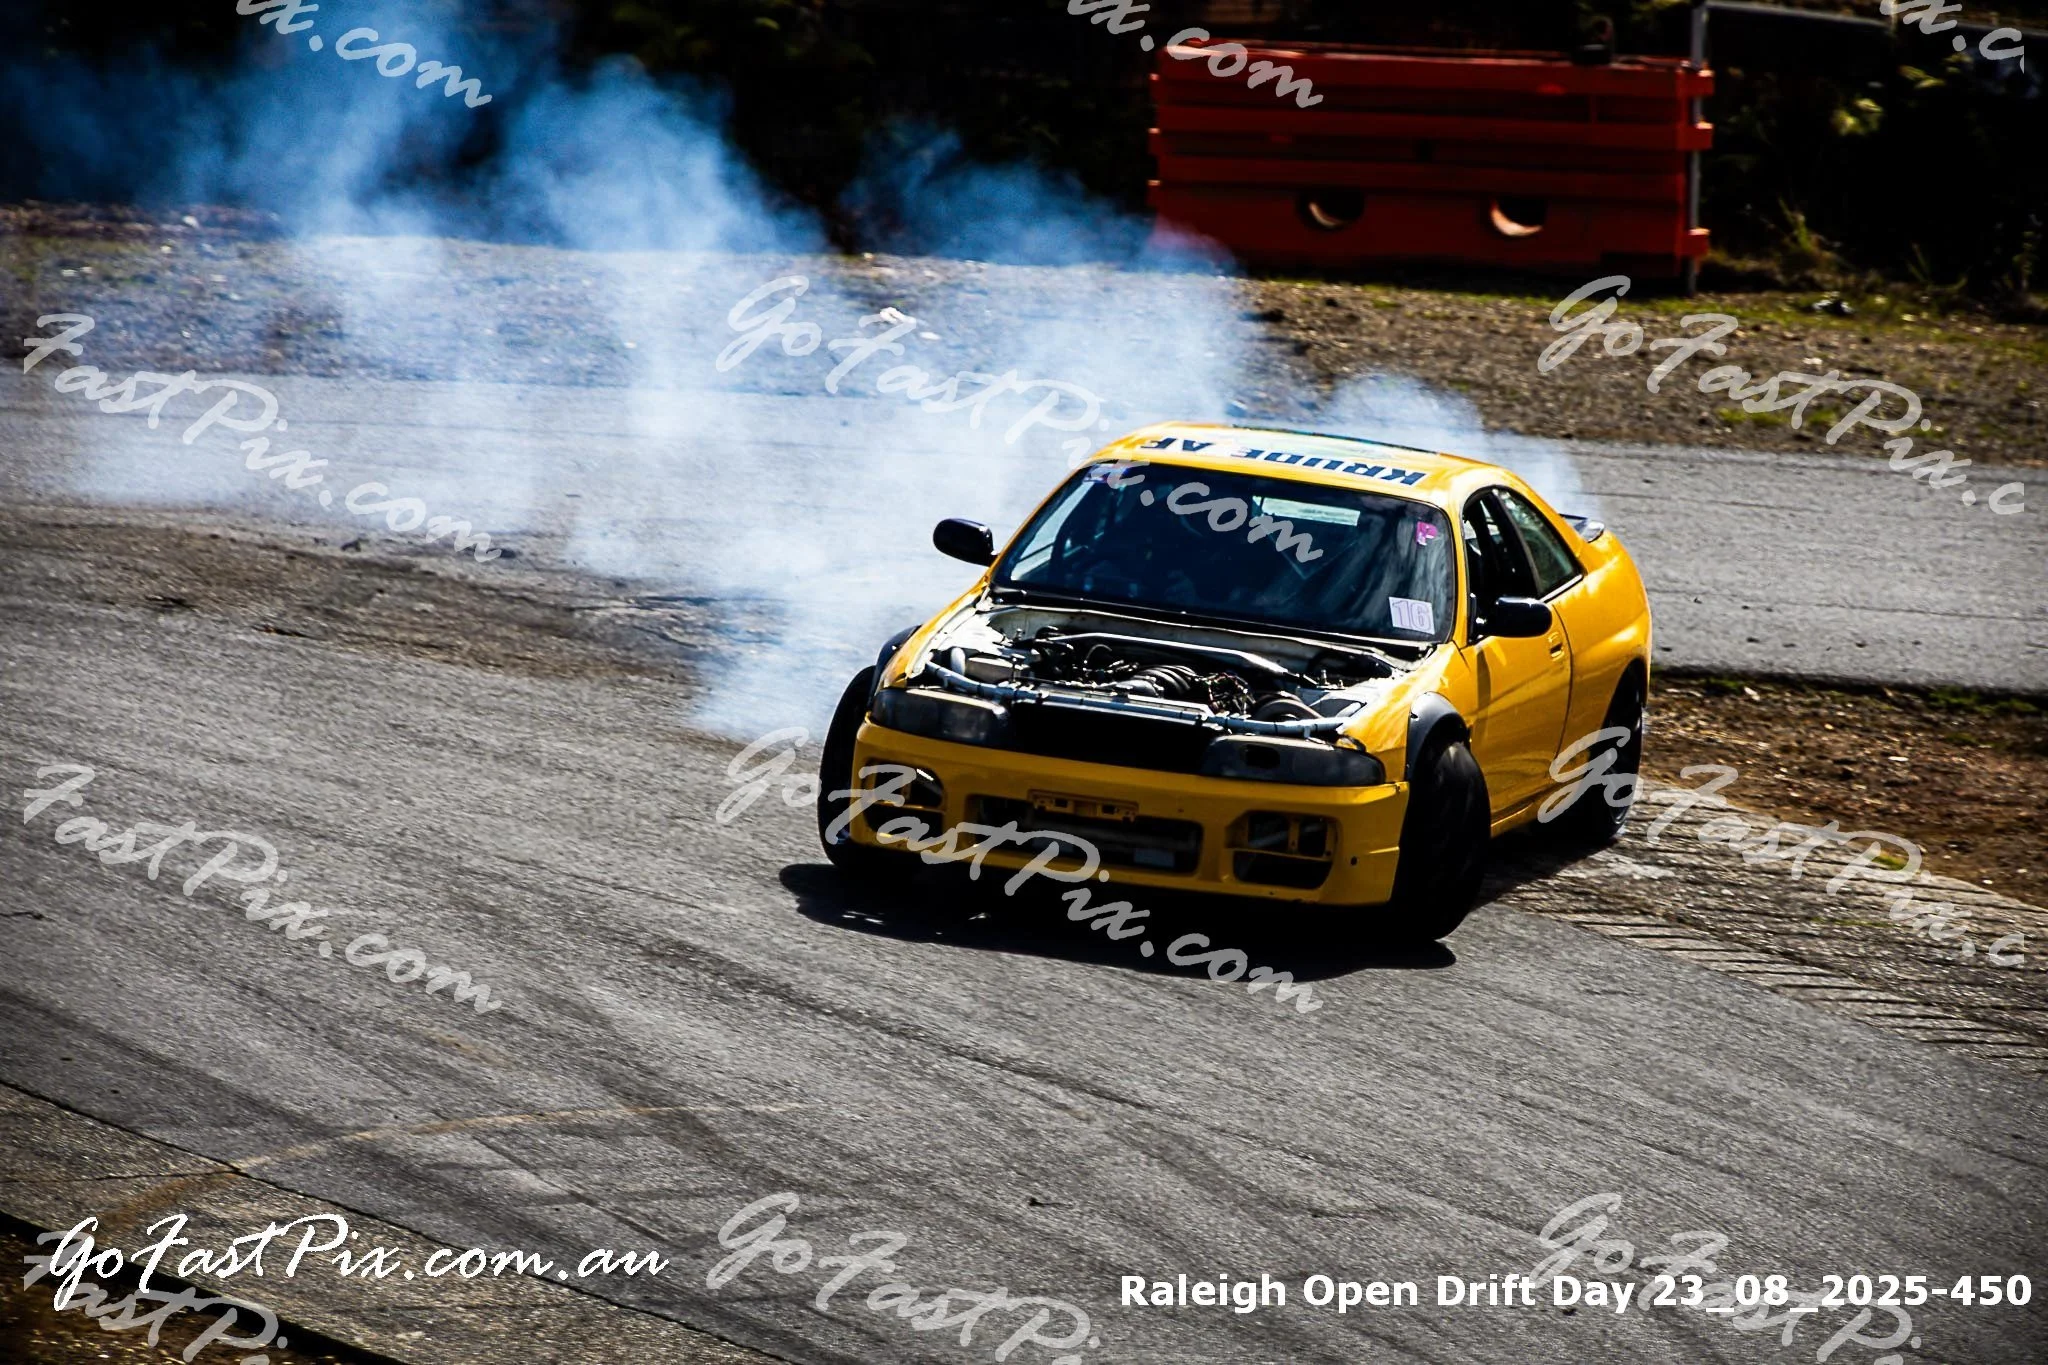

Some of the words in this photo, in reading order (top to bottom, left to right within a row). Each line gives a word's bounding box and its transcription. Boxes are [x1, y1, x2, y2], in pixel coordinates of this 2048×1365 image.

[1141, 438, 1214, 452] AF
[1231, 449, 1426, 486] KRUDE
[1392, 600, 1431, 631] 16
